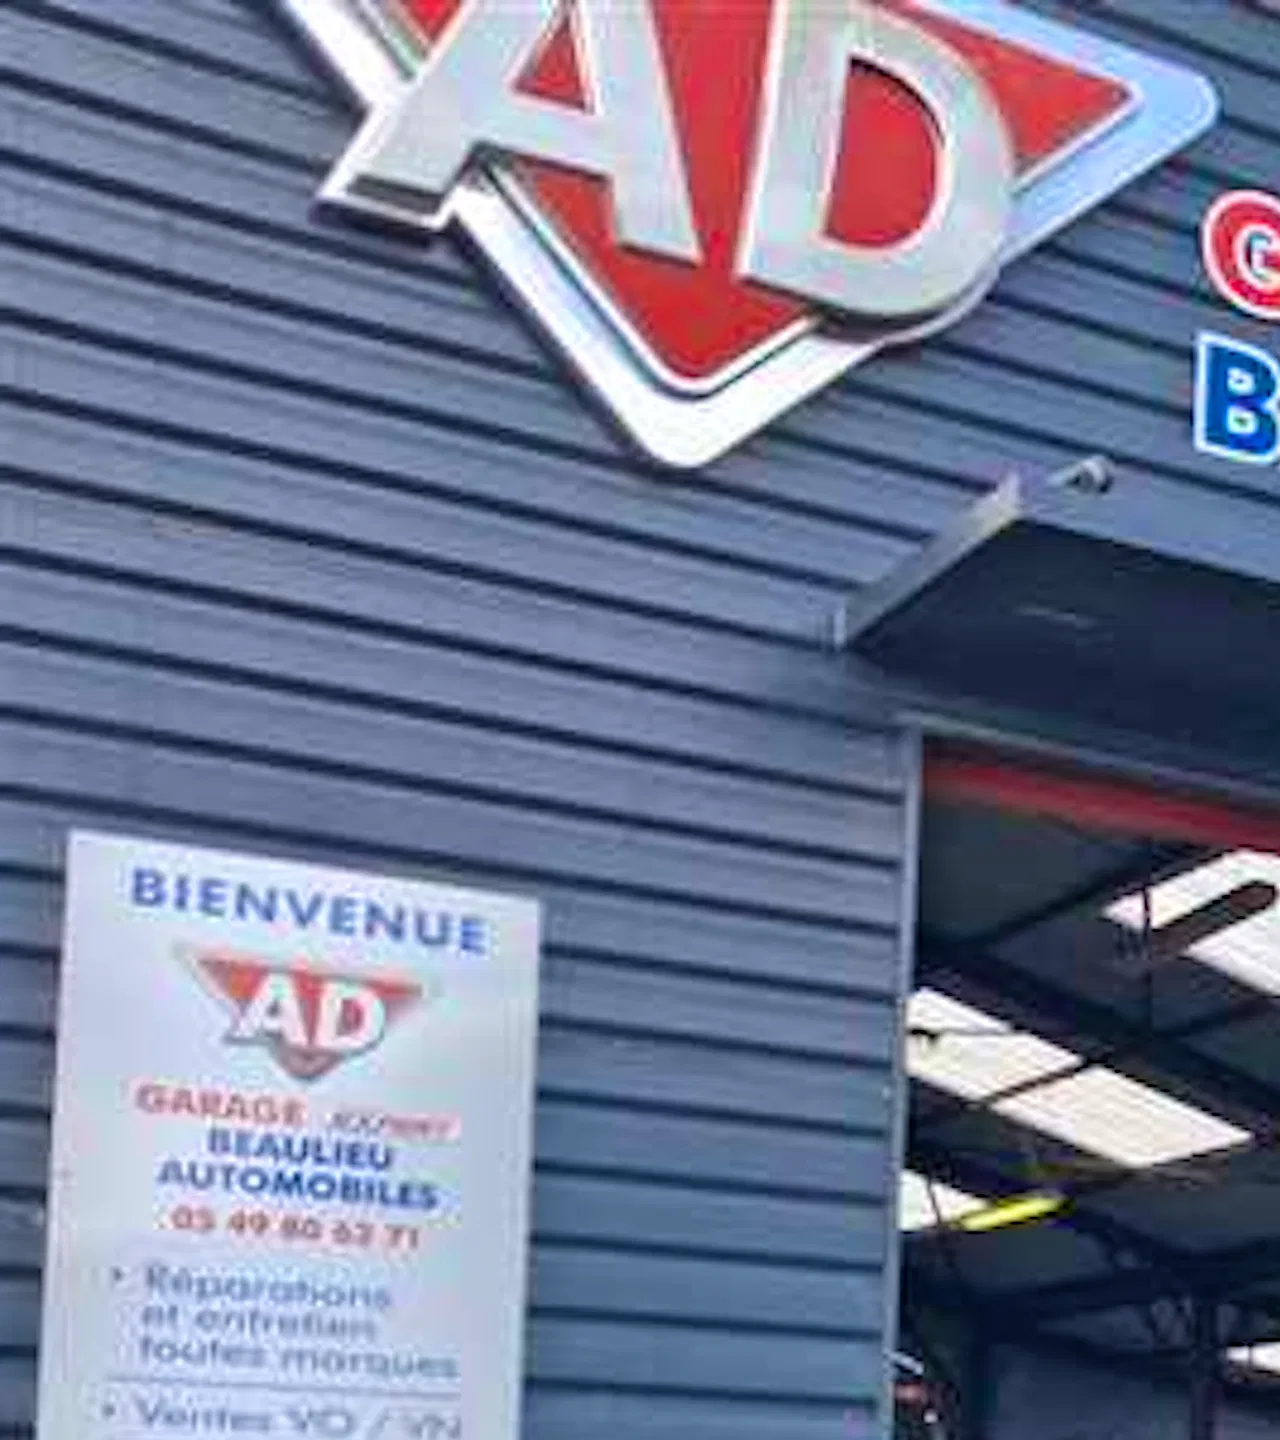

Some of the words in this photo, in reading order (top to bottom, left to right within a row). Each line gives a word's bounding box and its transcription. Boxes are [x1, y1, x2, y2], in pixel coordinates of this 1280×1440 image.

[318, 0, 1018, 318] AD
[131, 867, 490, 955] BIENVENUE
[222, 968, 388, 1050] AD
[134, 1083, 308, 1127] GARAGE
[207, 1126, 394, 1170] BEAULIEU
[157, 1159, 439, 1209] AUTOMOBILES
[170, 1206, 214, 1231] 05
[227, 1209, 270, 1235] 49
[385, 1225, 420, 1248] 71
[141, 1336, 266, 1367] toutes
[280, 1350, 460, 1381] marques
[137, 1398, 271, 1431] Ventes
